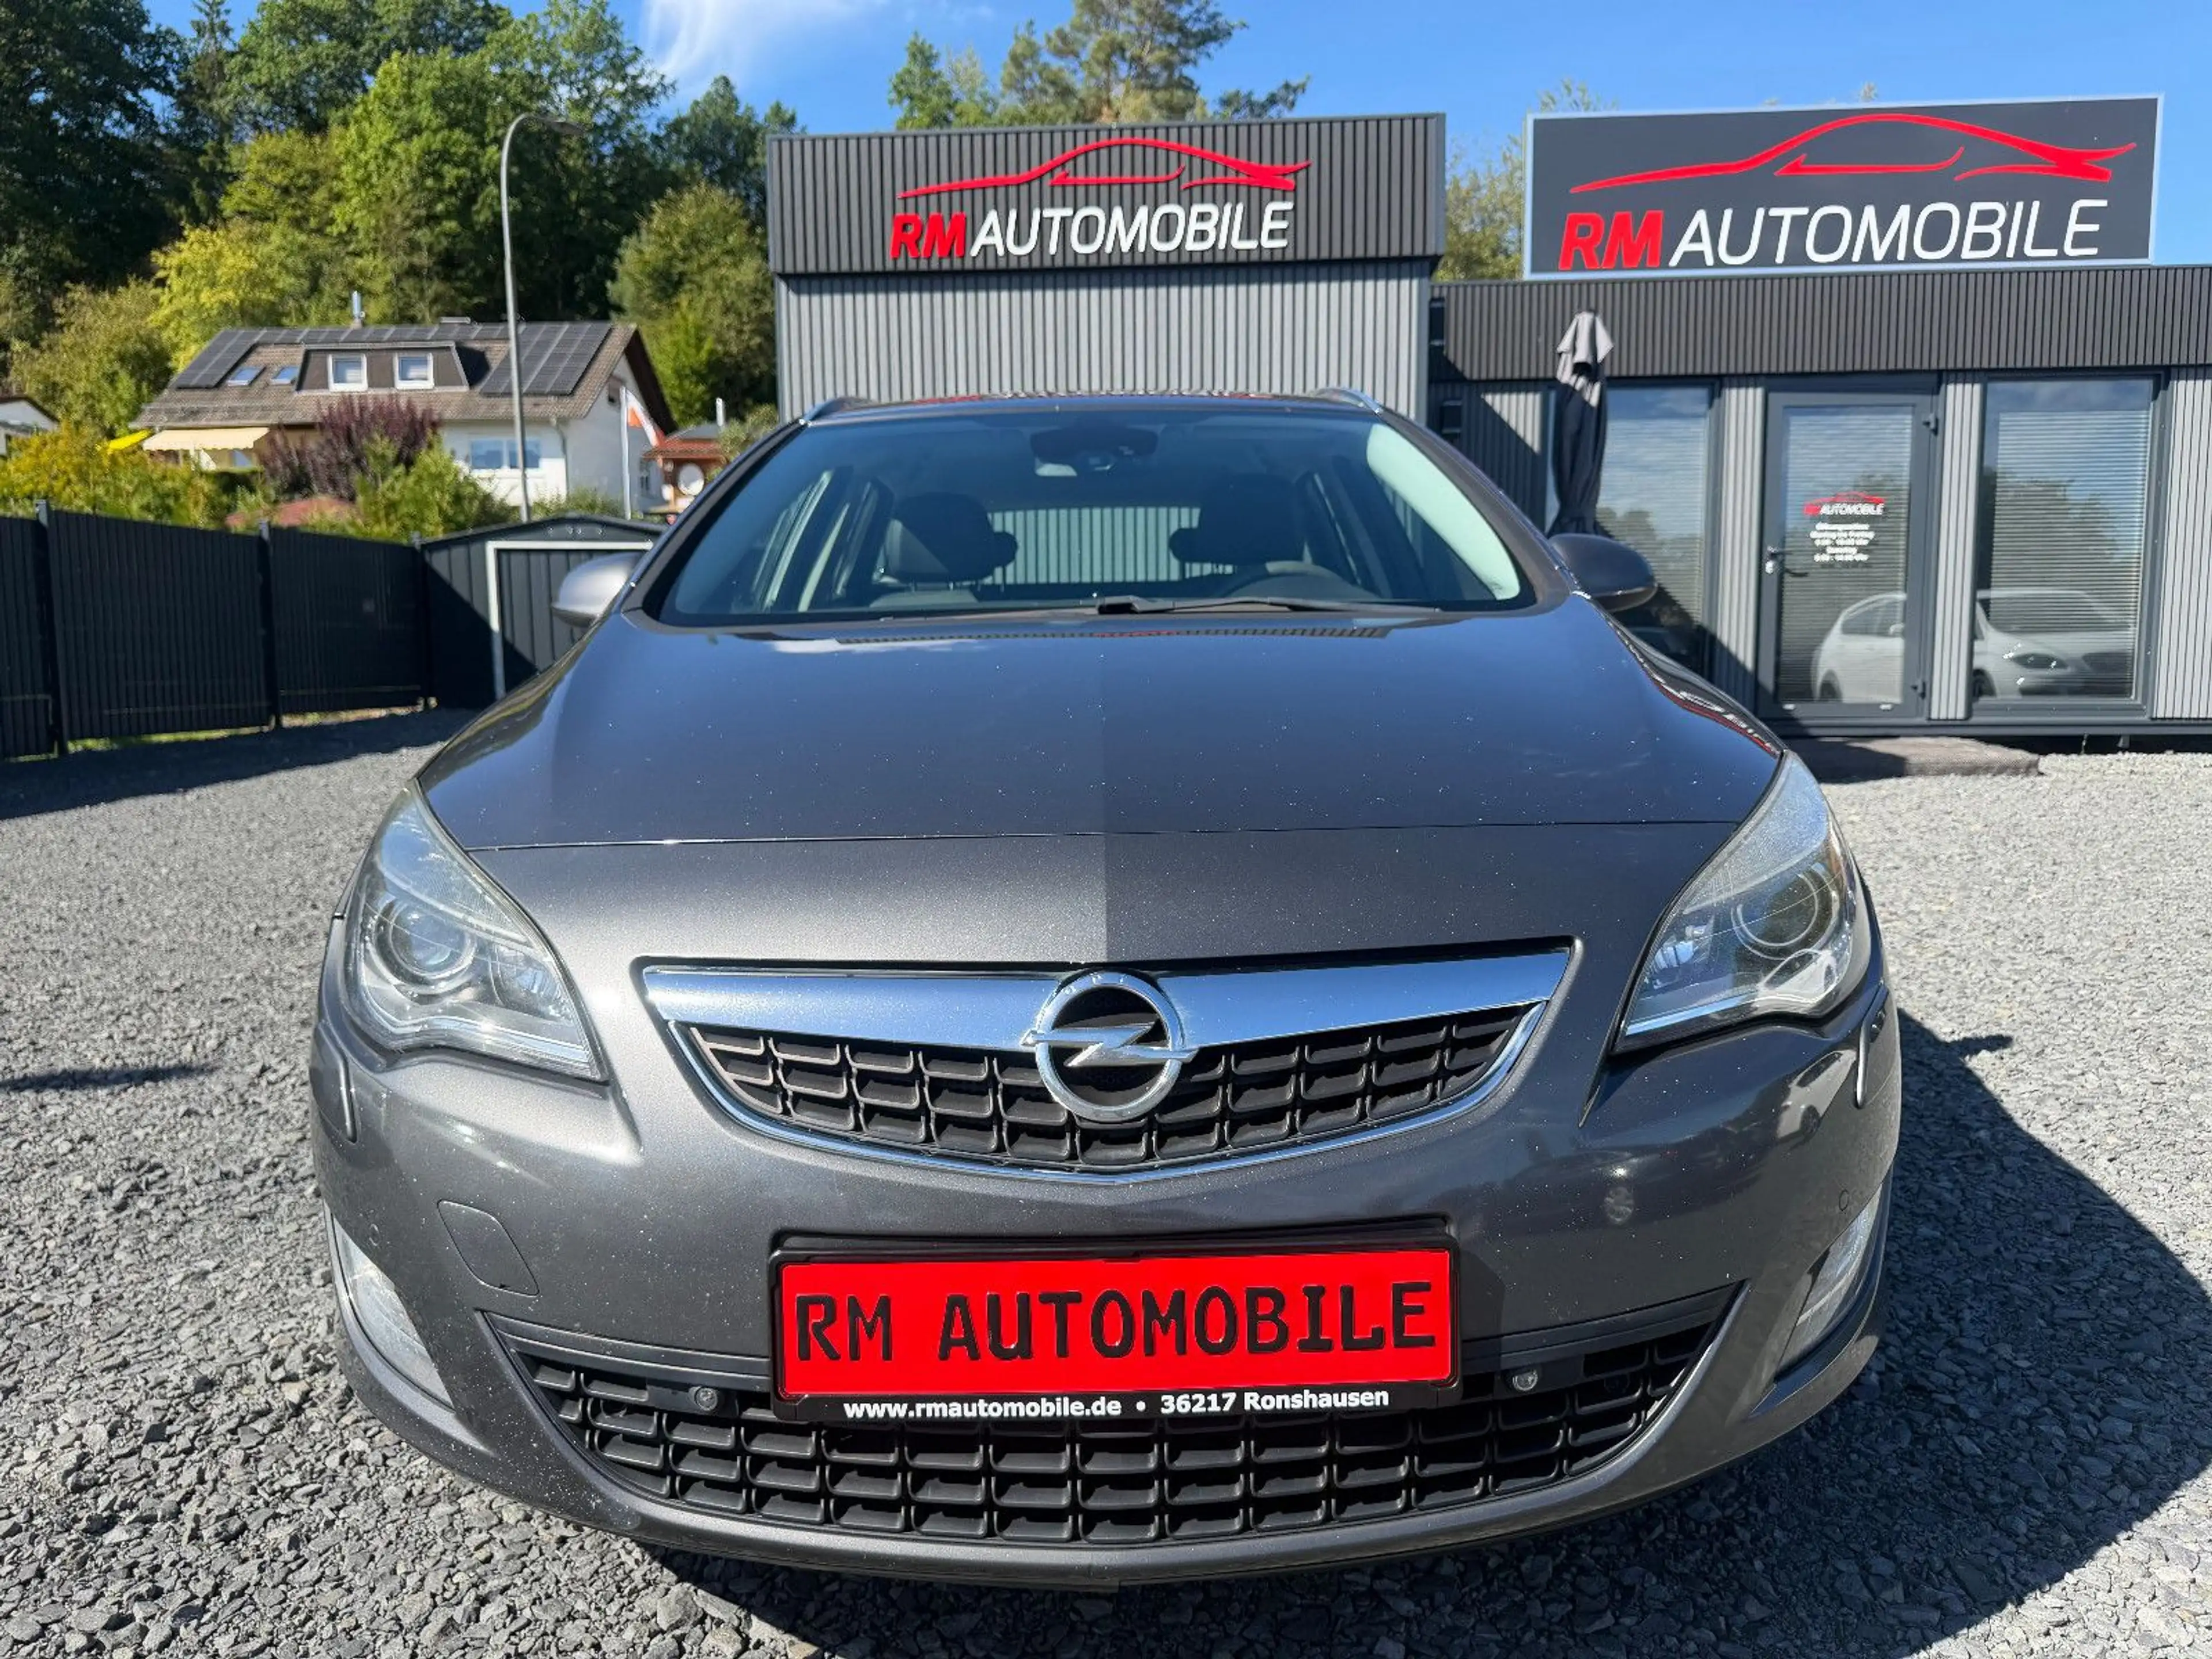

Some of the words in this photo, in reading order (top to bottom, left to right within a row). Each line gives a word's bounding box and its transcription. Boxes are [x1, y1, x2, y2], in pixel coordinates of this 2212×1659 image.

[889, 211, 967, 259] RM
[970, 202, 1294, 257] AUTOMOBILE
[1558, 210, 1664, 270] RM
[1668, 199, 2108, 267] AUTOMOBILE
[1819, 503, 1884, 515] AUTOMOBILE
[797, 1296, 892, 1361] RM
[938, 1282, 1435, 1361] AUTOMOBILE
[843, 1396, 1122, 1418] www.rmautomobile.de
[1161, 1392, 1237, 1414] 36217
[1244, 1389, 1389, 1410] Ronshausen
